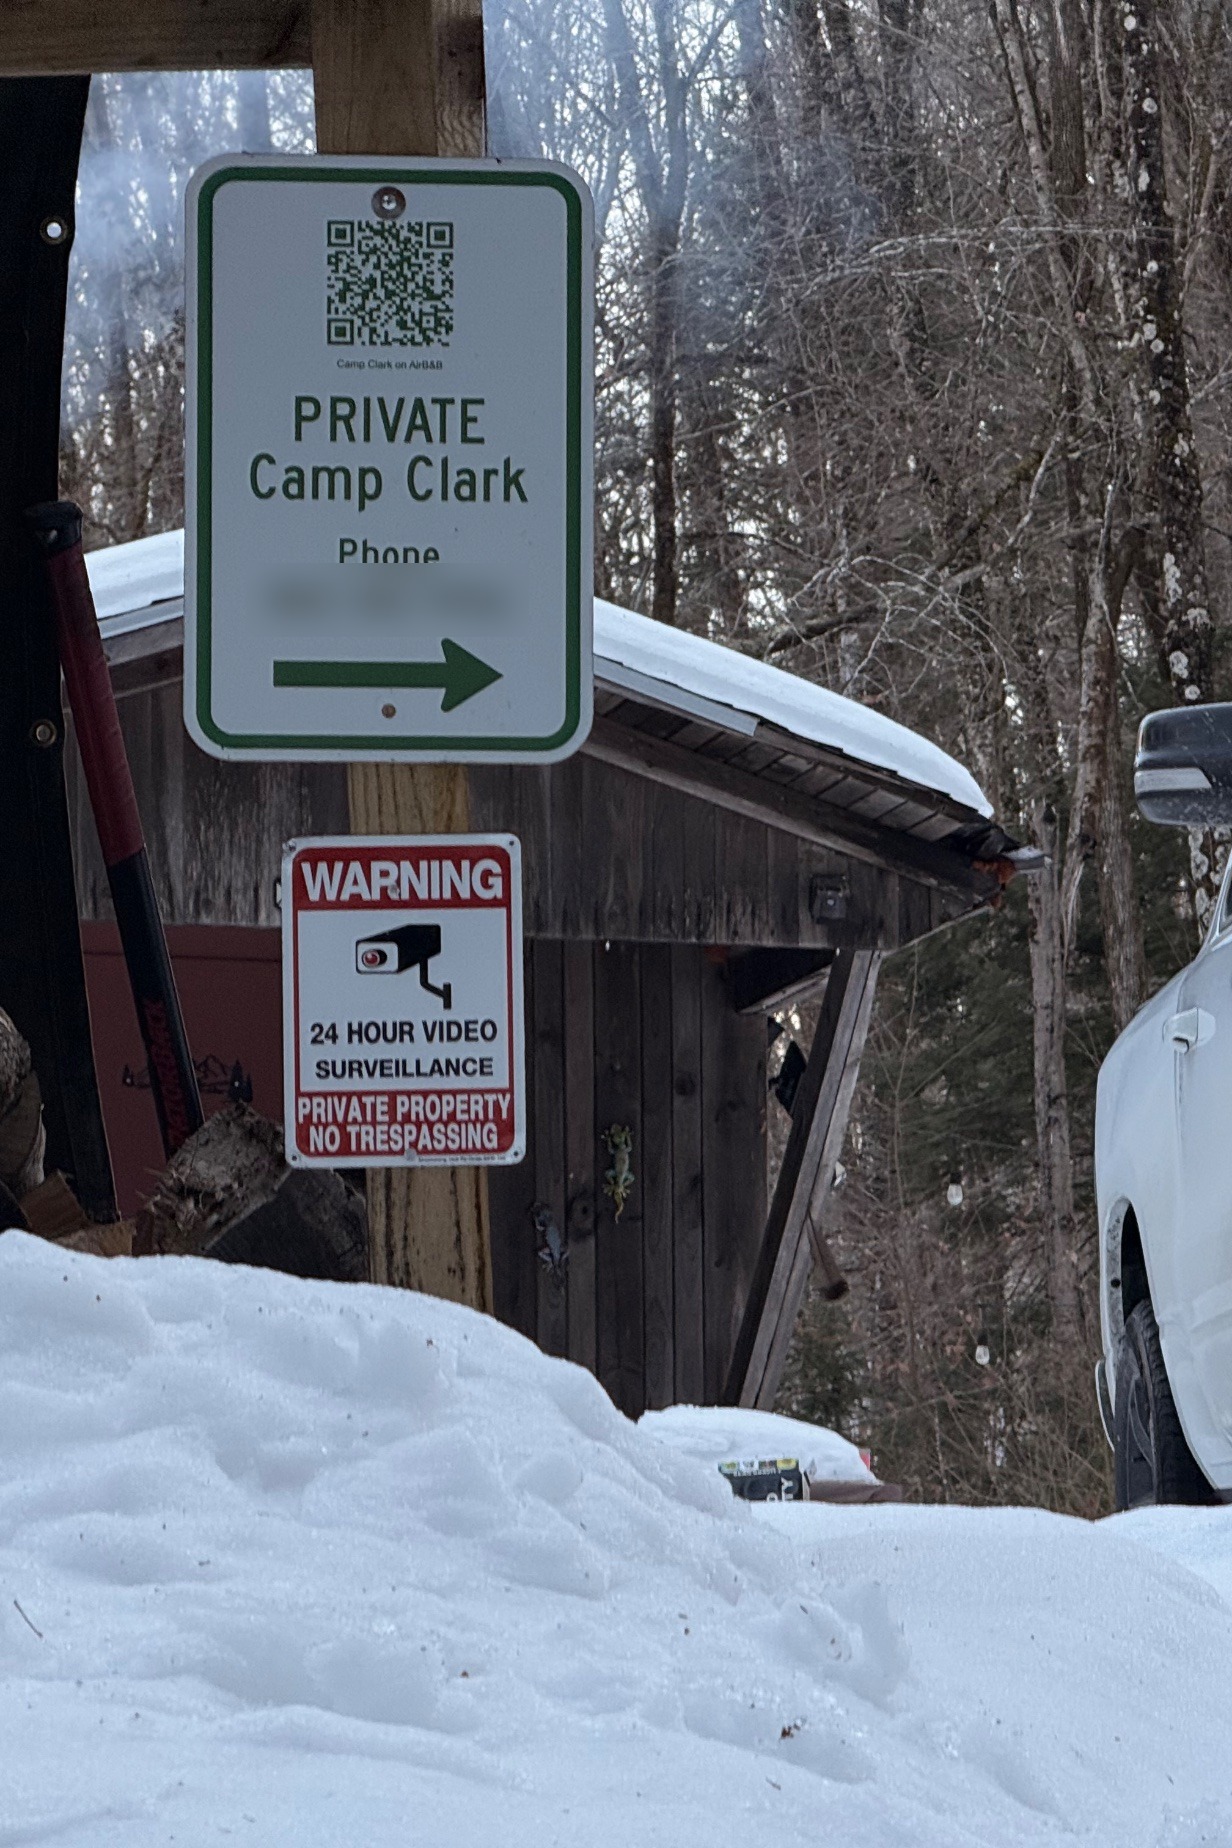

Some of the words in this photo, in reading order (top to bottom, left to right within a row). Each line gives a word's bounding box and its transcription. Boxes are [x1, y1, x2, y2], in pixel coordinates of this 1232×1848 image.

[336, 358, 366, 370] Camp
[367, 358, 392, 369] Clark
[394, 361, 407, 369] on
[294, 395, 486, 445] PRIVATE
[249, 452, 383, 512] Camp
[406, 455, 529, 503] Clark
[338, 538, 441, 564] Phone
[301, 858, 503, 902] WARNING
[310, 1022, 339, 1045] 24
[347, 1020, 415, 1044] HOUR
[421, 1018, 498, 1043] VIDEO
[315, 1057, 494, 1080] SURVEILLANCE
[299, 1095, 390, 1124] PRIVATE
[395, 1093, 511, 1121] PROPERTY
[309, 1125, 341, 1153] NO
[347, 1122, 499, 1151] TRESPASSING
